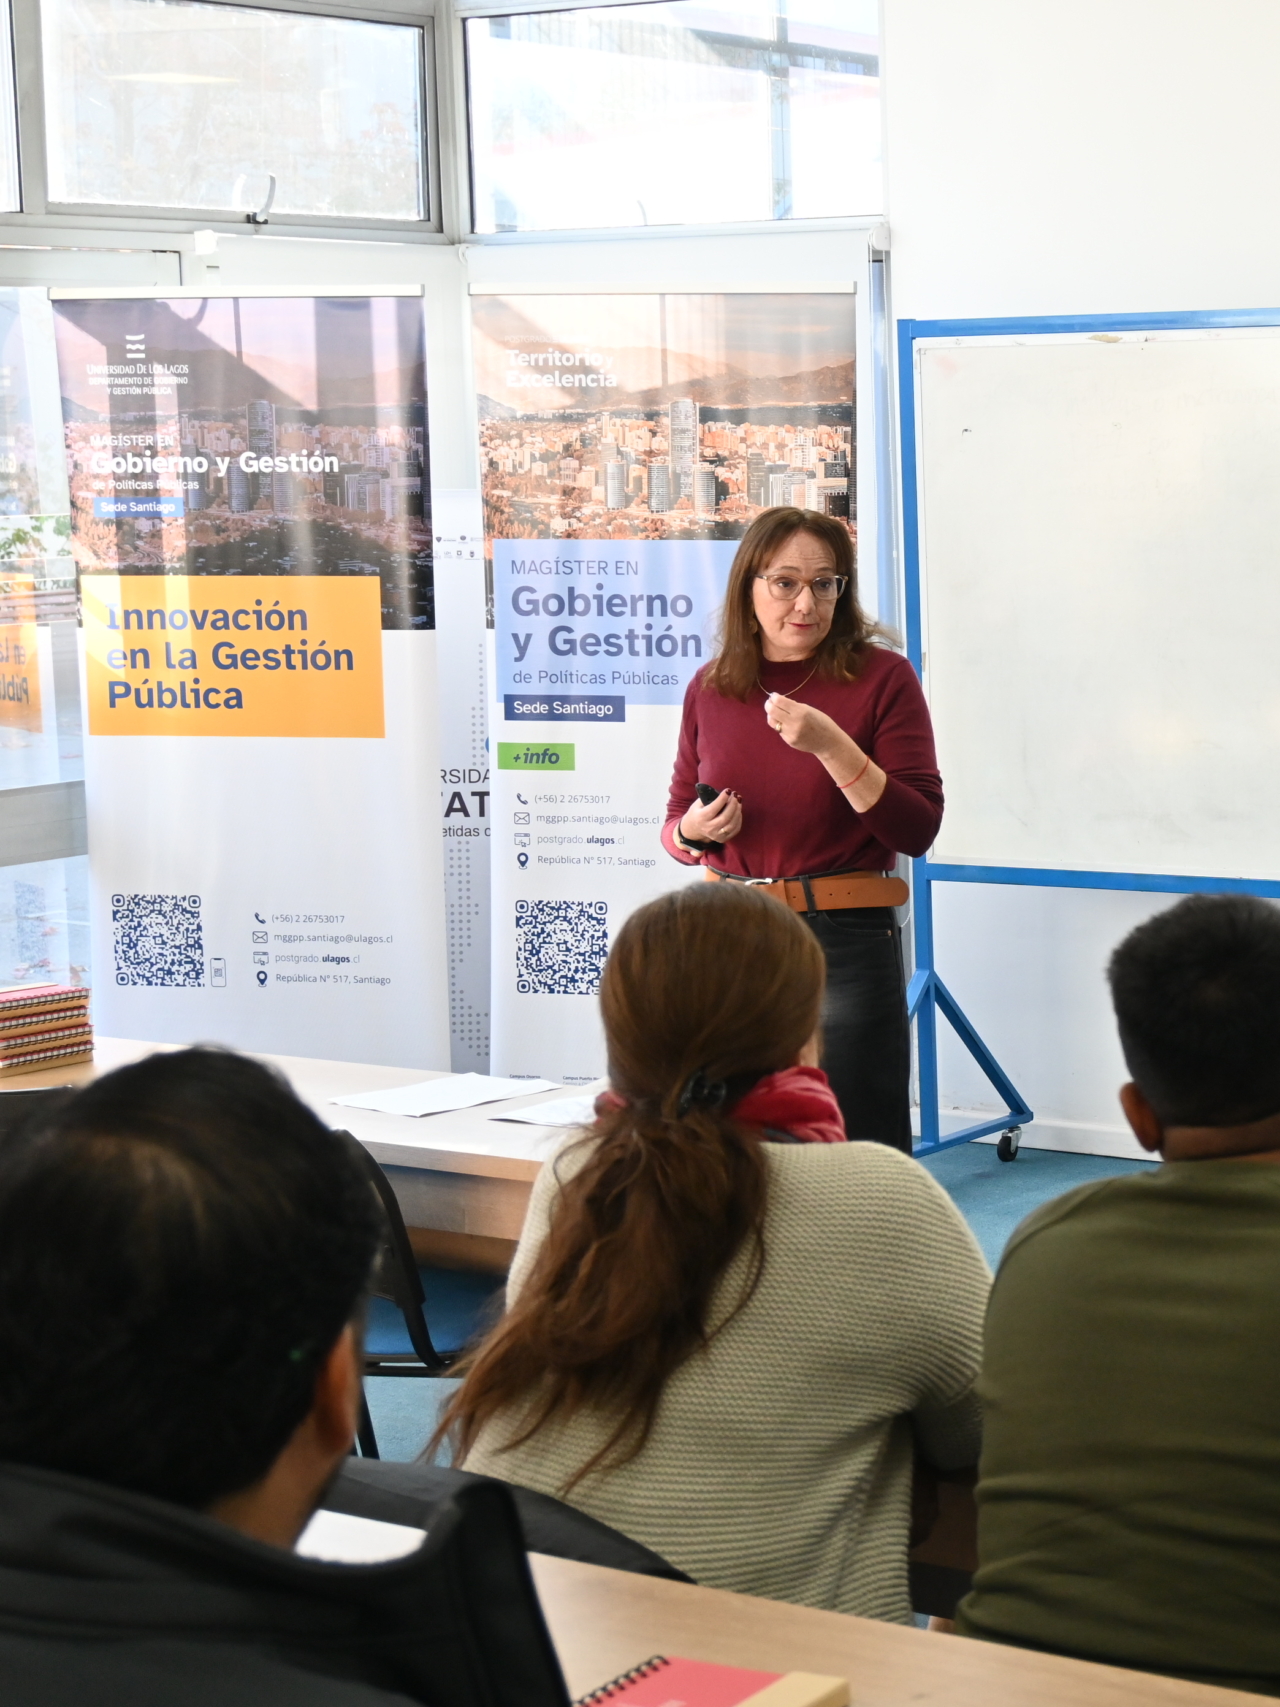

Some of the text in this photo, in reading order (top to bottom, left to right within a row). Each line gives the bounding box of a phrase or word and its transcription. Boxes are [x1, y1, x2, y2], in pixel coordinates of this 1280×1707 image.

[505, 348, 603, 366] Territorio
[88, 376, 188, 385] DEPARTAMENTO DE GOBIERNO
[505, 369, 617, 387] Excelencia
[107, 385, 172, 395] Y GESTIÓN PÚBLICA
[90, 434, 174, 447] MAGÍSTER EN
[92, 449, 339, 477] Gobierno y Gestión
[92, 478, 199, 490] de Políticas Públicas
[101, 502, 175, 515] Sede Santiago
[511, 556, 639, 576] MAGÍSTER EN
[511, 583, 693, 618] Gobierno
[105, 598, 308, 631] Innovación
[511, 623, 701, 663] y Gestión
[106, 638, 354, 670] en la Gestión
[512, 670, 679, 685] de Políticas Públicas
[108, 677, 244, 710] Pública
[514, 701, 613, 717] Sede Santiago
[534, 794, 610, 804] (+56) 2 26753017
[536, 814, 660, 825] mggpp.santiago@ulagos.cl
[537, 835, 625, 846] postgrado.ulagos.cl
[537, 855, 581, 867] República
[597, 857, 615, 867] 517,
[617, 857, 656, 868] Santiago
[271, 914, 345, 924] (+56) 2 26753017
[274, 933, 393, 945] mggpp.santiago@ulagos.cl
[275, 953, 360, 965] postgrado.ulagos.cl
[276, 973, 317, 985] República
[333, 974, 351, 985] 517,
[354, 975, 391, 986] Santiago
